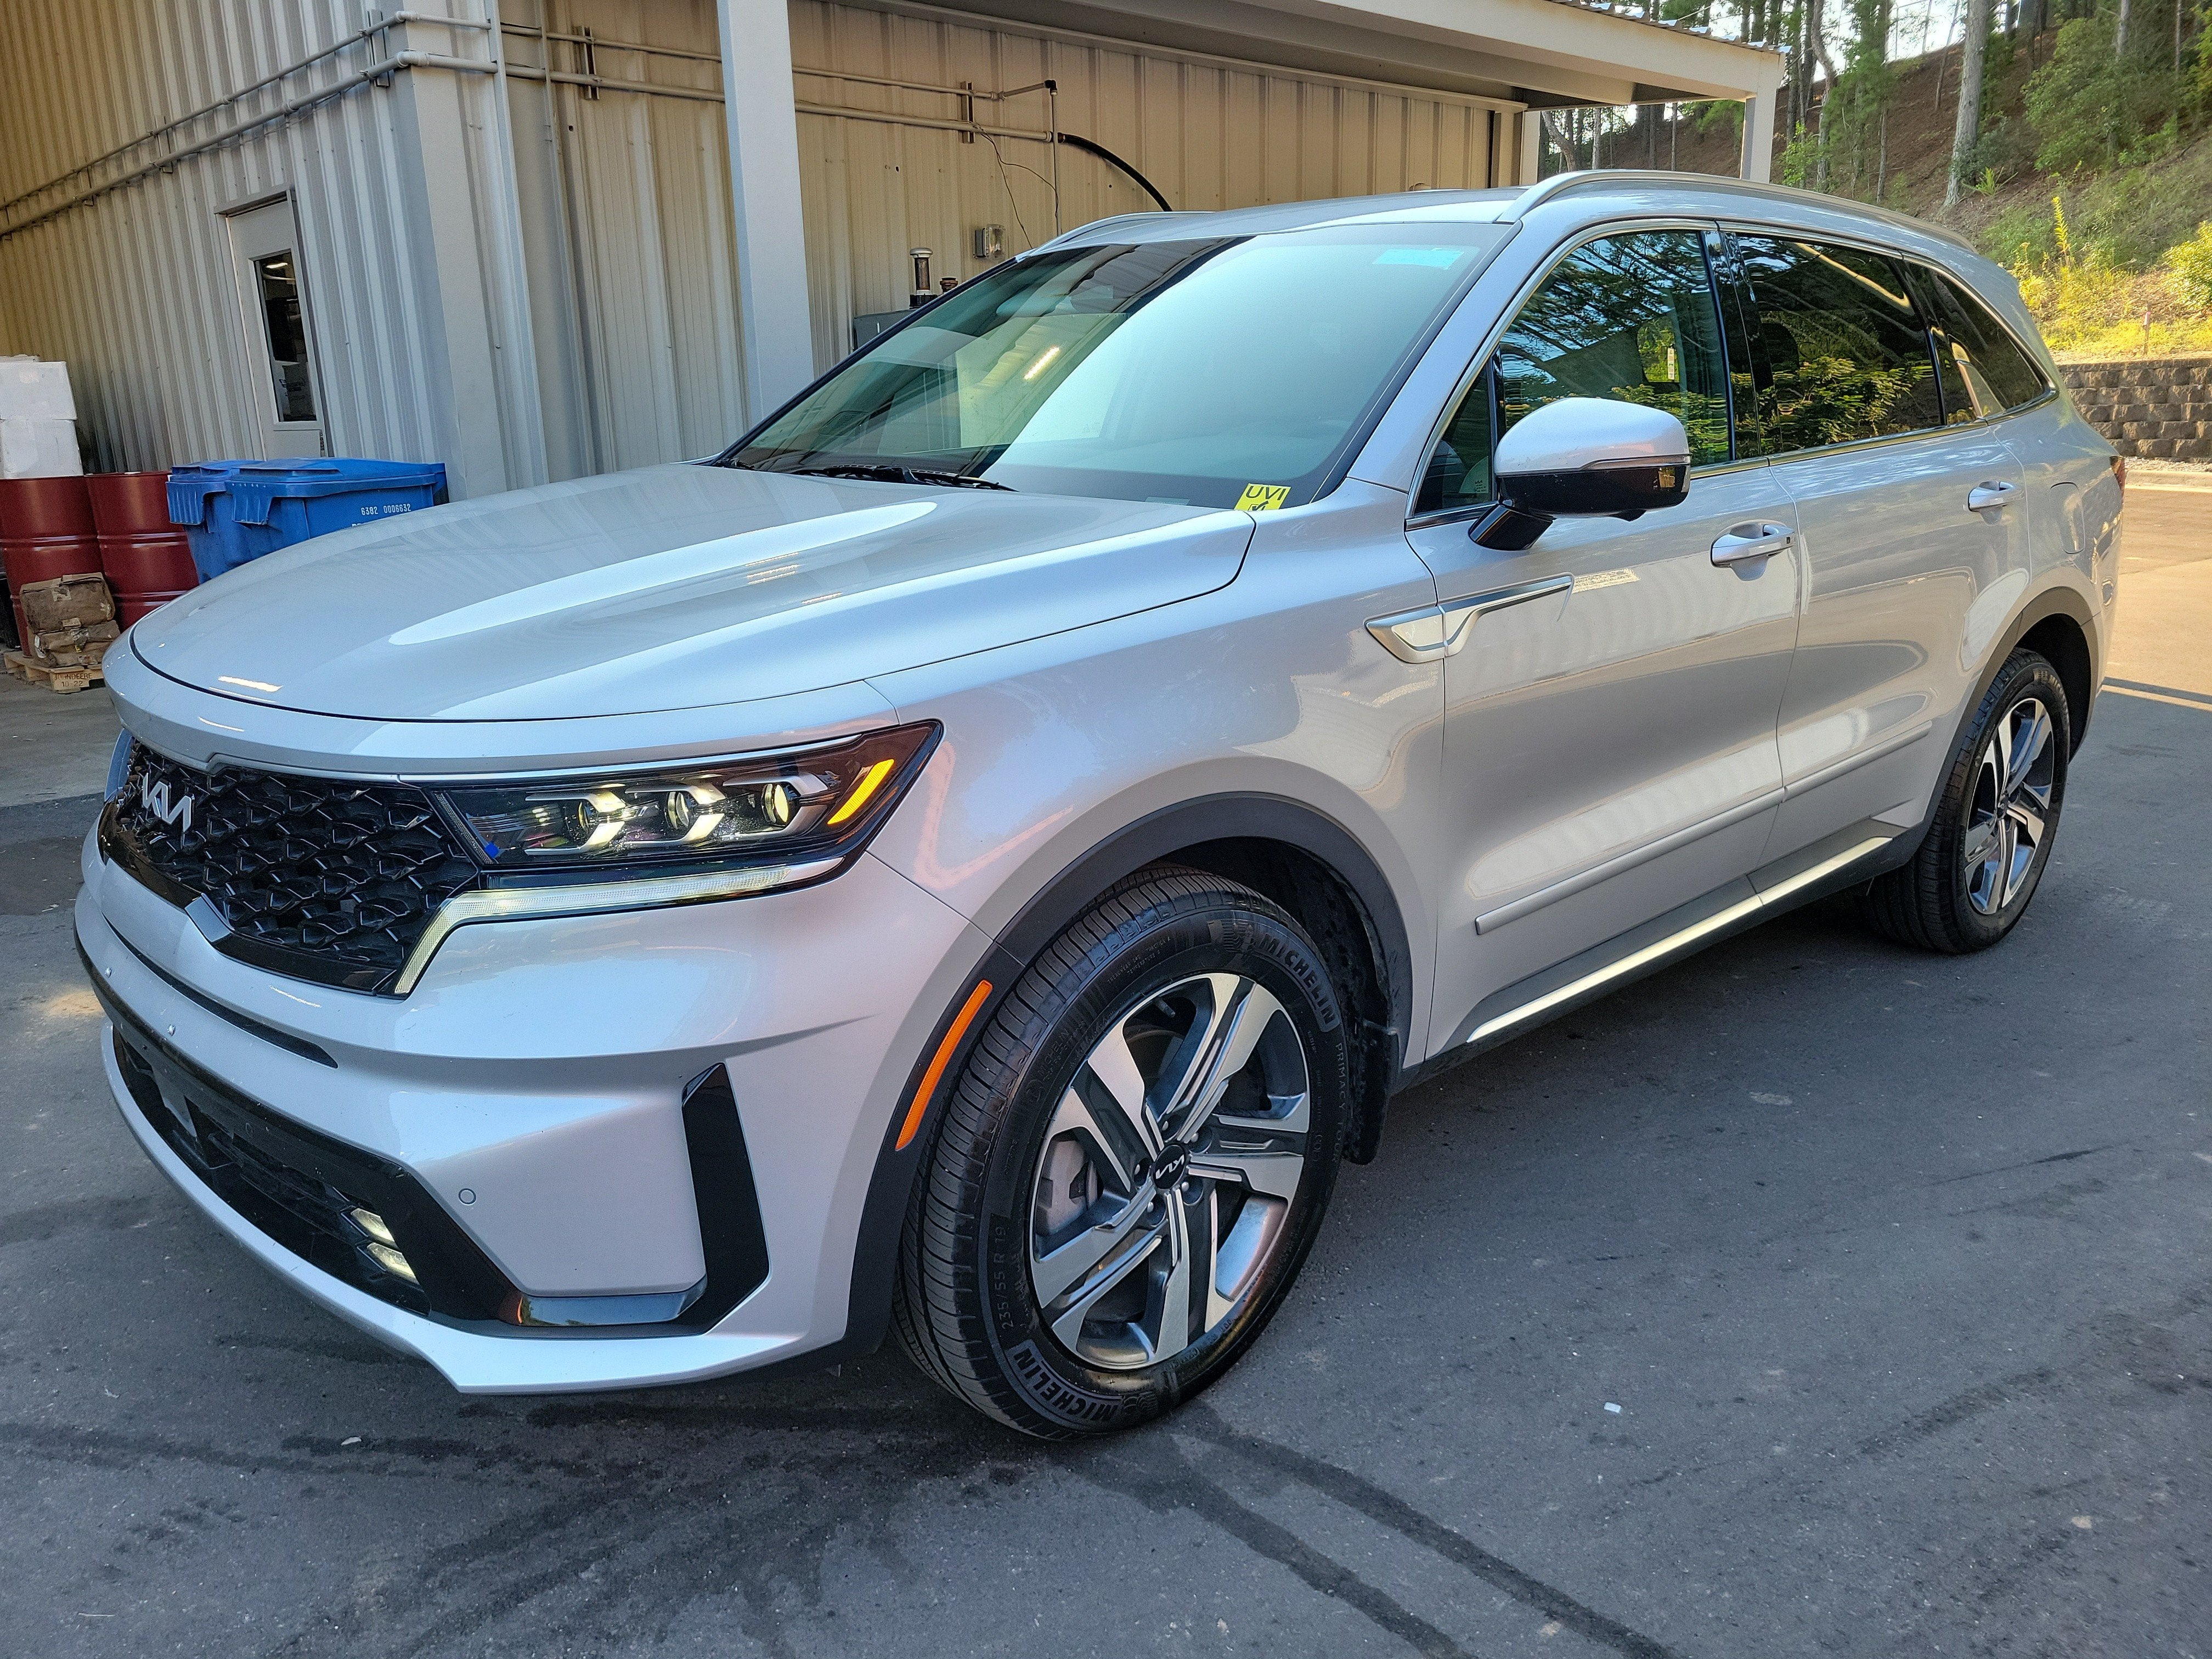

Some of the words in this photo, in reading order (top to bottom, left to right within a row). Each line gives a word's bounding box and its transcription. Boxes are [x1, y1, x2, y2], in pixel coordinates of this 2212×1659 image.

[361, 506, 379, 515] 6382
[383, 504, 411, 514] 0006632
[1246, 486, 1286, 500] UVI
[143, 772, 191, 832] KIA
[1260, 933, 1335, 1024] MICHELIN
[1335, 1043, 1345, 1109] PRIMACY
[1155, 1154, 1184, 1180] KIA
[1013, 1347, 1118, 1421] MICHELIN
